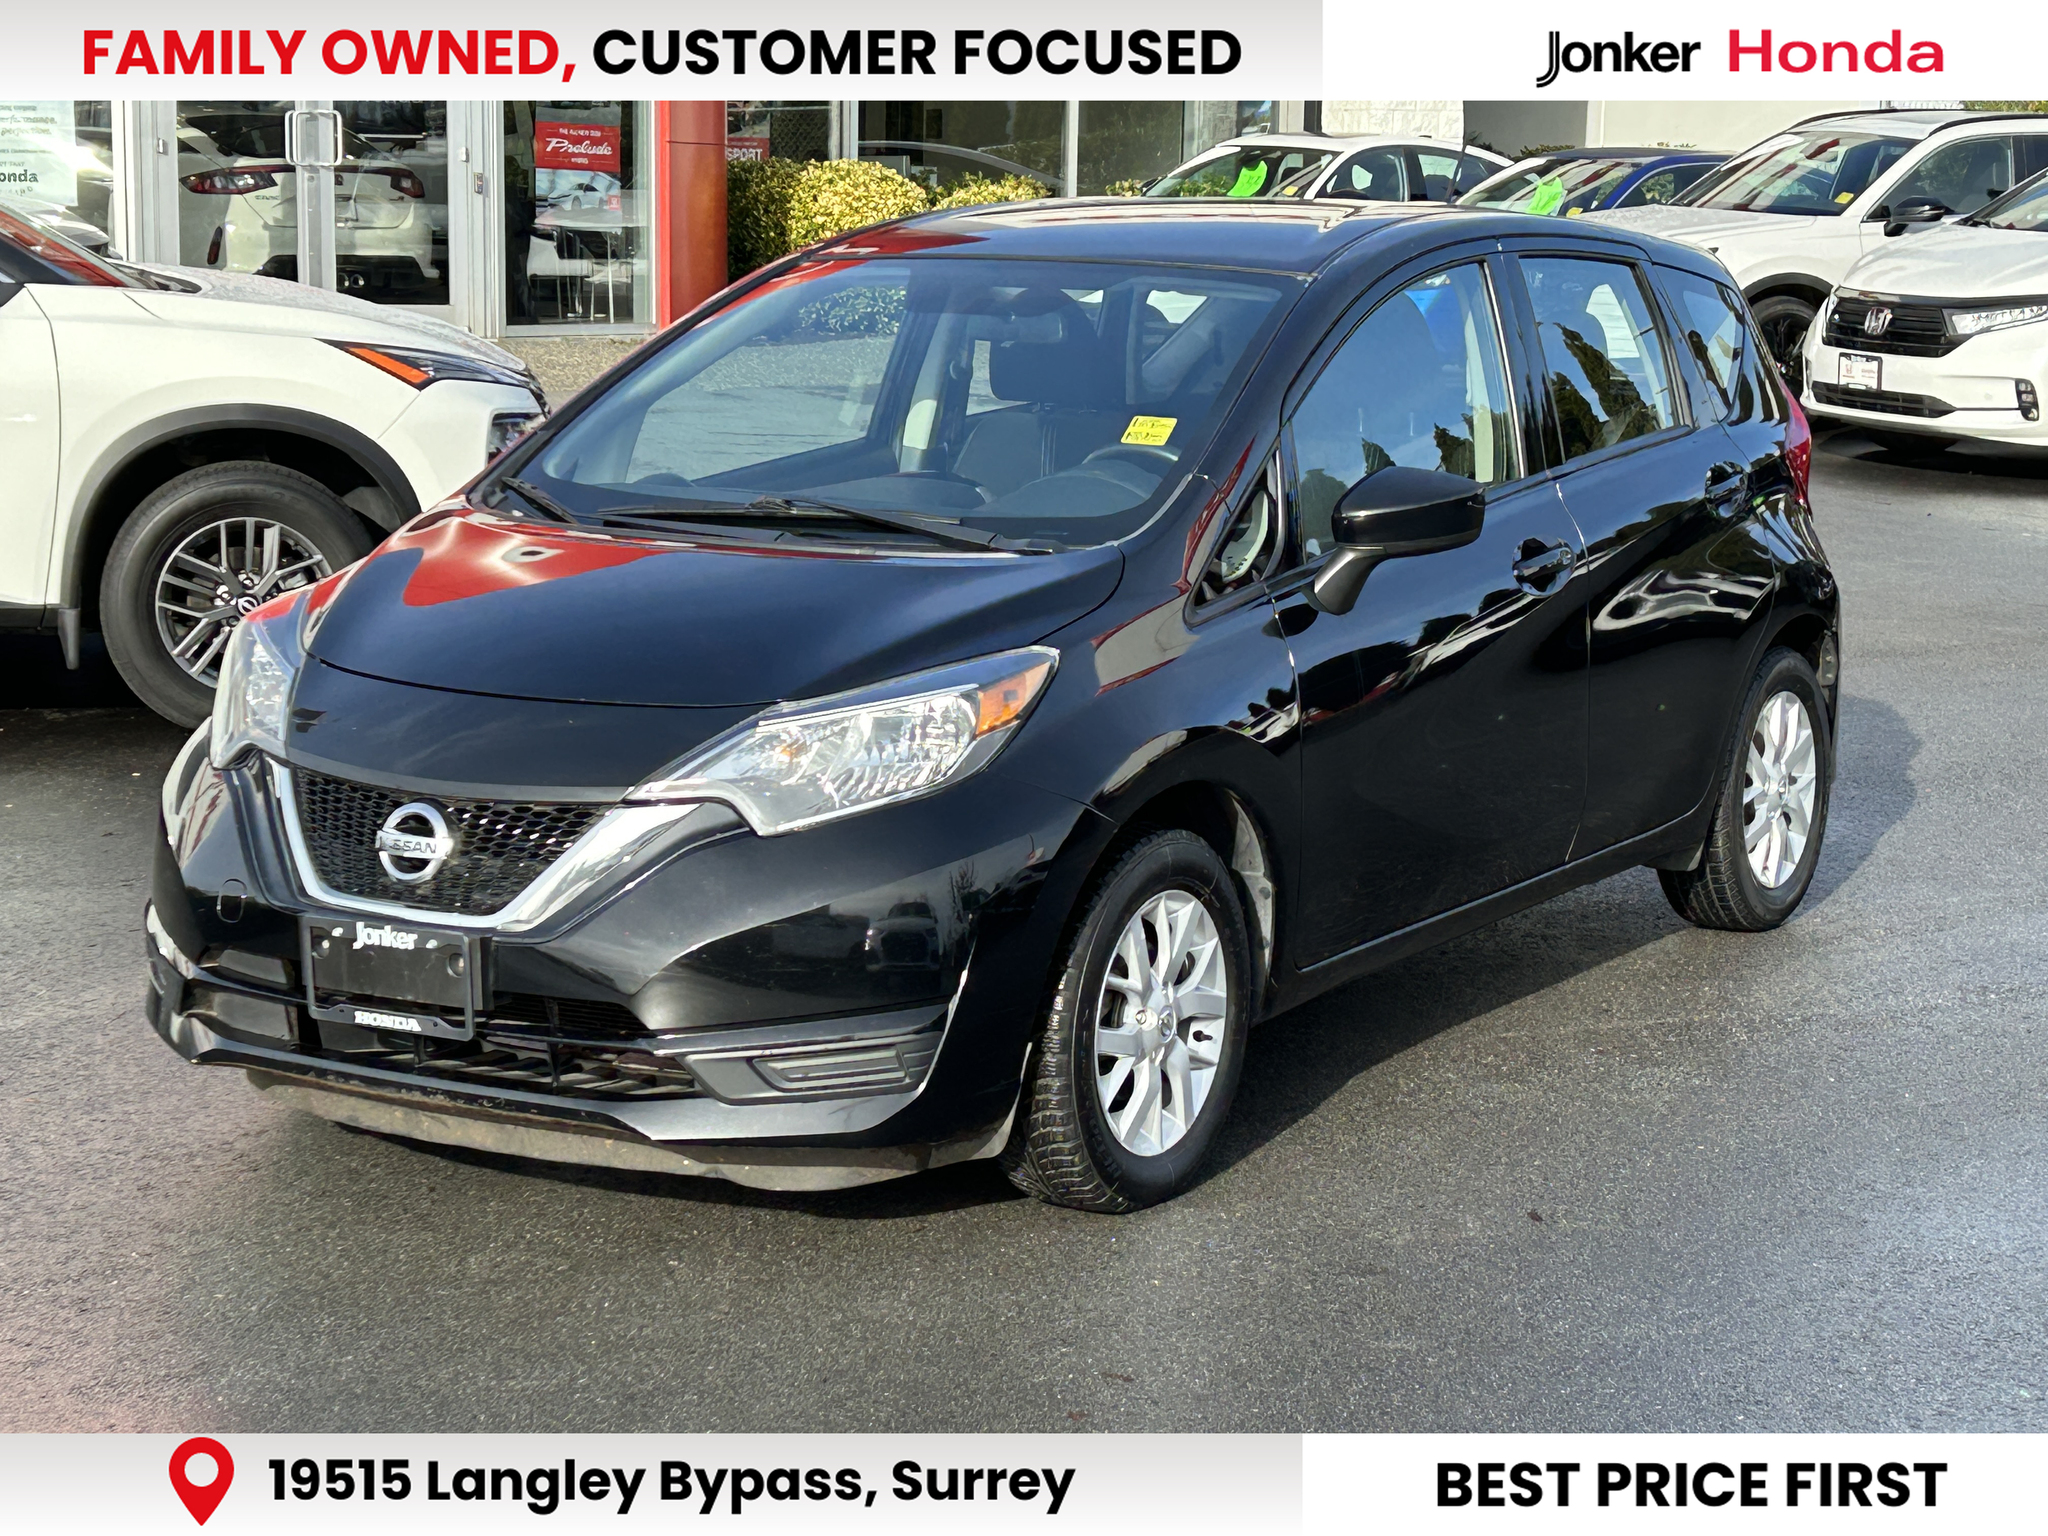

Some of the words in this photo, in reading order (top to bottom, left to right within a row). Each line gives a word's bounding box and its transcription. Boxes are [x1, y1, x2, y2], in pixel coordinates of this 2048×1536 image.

[545, 137, 613, 156] Prelude
[352, 921, 418, 950] Jonker
[353, 1010, 422, 1032] HONDA
